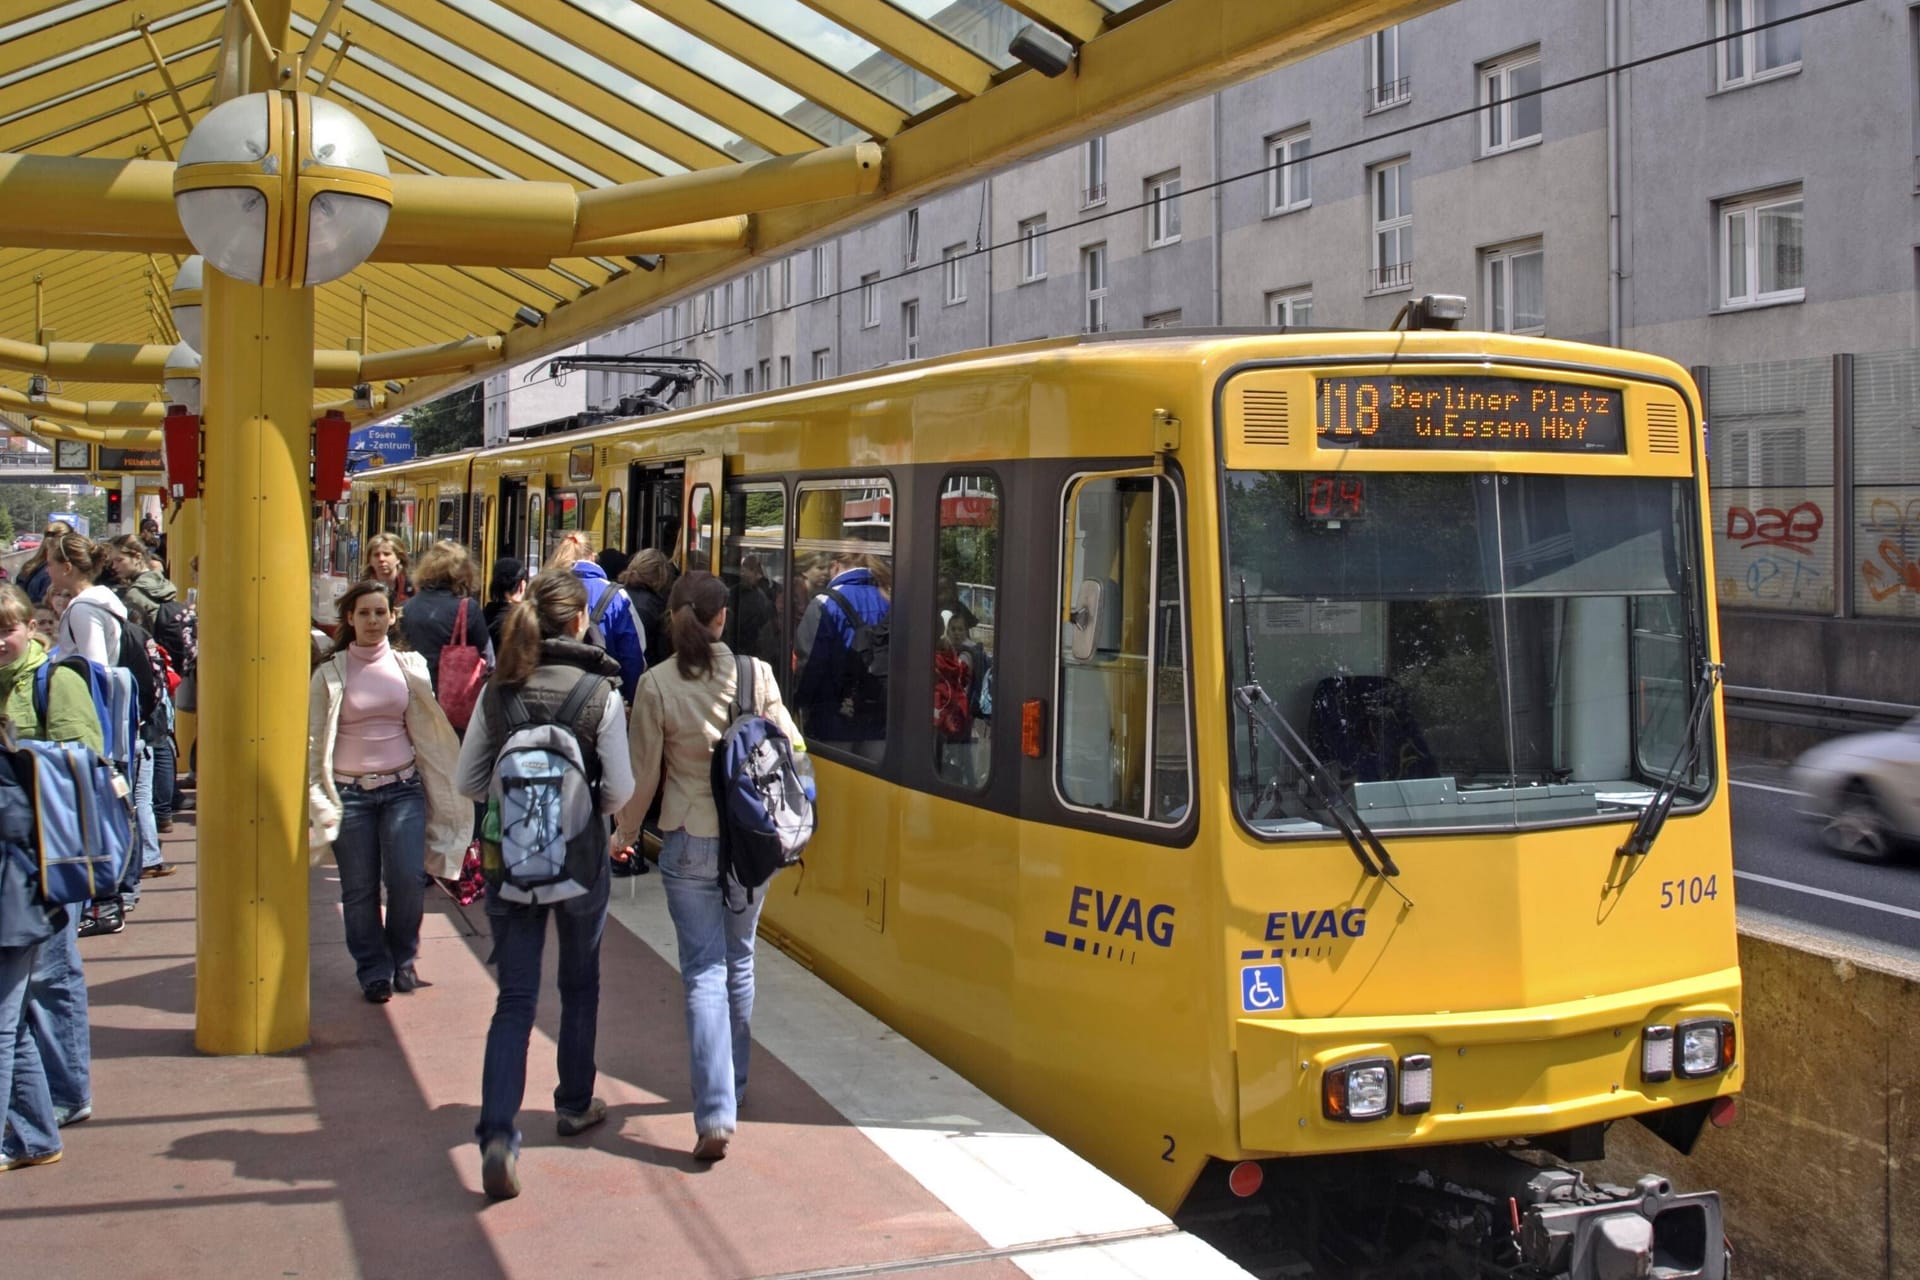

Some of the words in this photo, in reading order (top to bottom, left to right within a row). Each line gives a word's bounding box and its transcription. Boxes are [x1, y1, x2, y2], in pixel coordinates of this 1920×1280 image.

[1390, 385, 1519, 411] Berliner
[1531, 389, 1609, 413] Platz
[368, 429, 396, 439] Essen
[1541, 416, 1588, 439] Hbf
[1309, 480, 1363, 515] 04
[1660, 874, 1718, 909] 5104
[1068, 885, 1176, 948] EVAG
[1264, 907, 1367, 942] EVAG
[1161, 1134, 1176, 1163] 2
